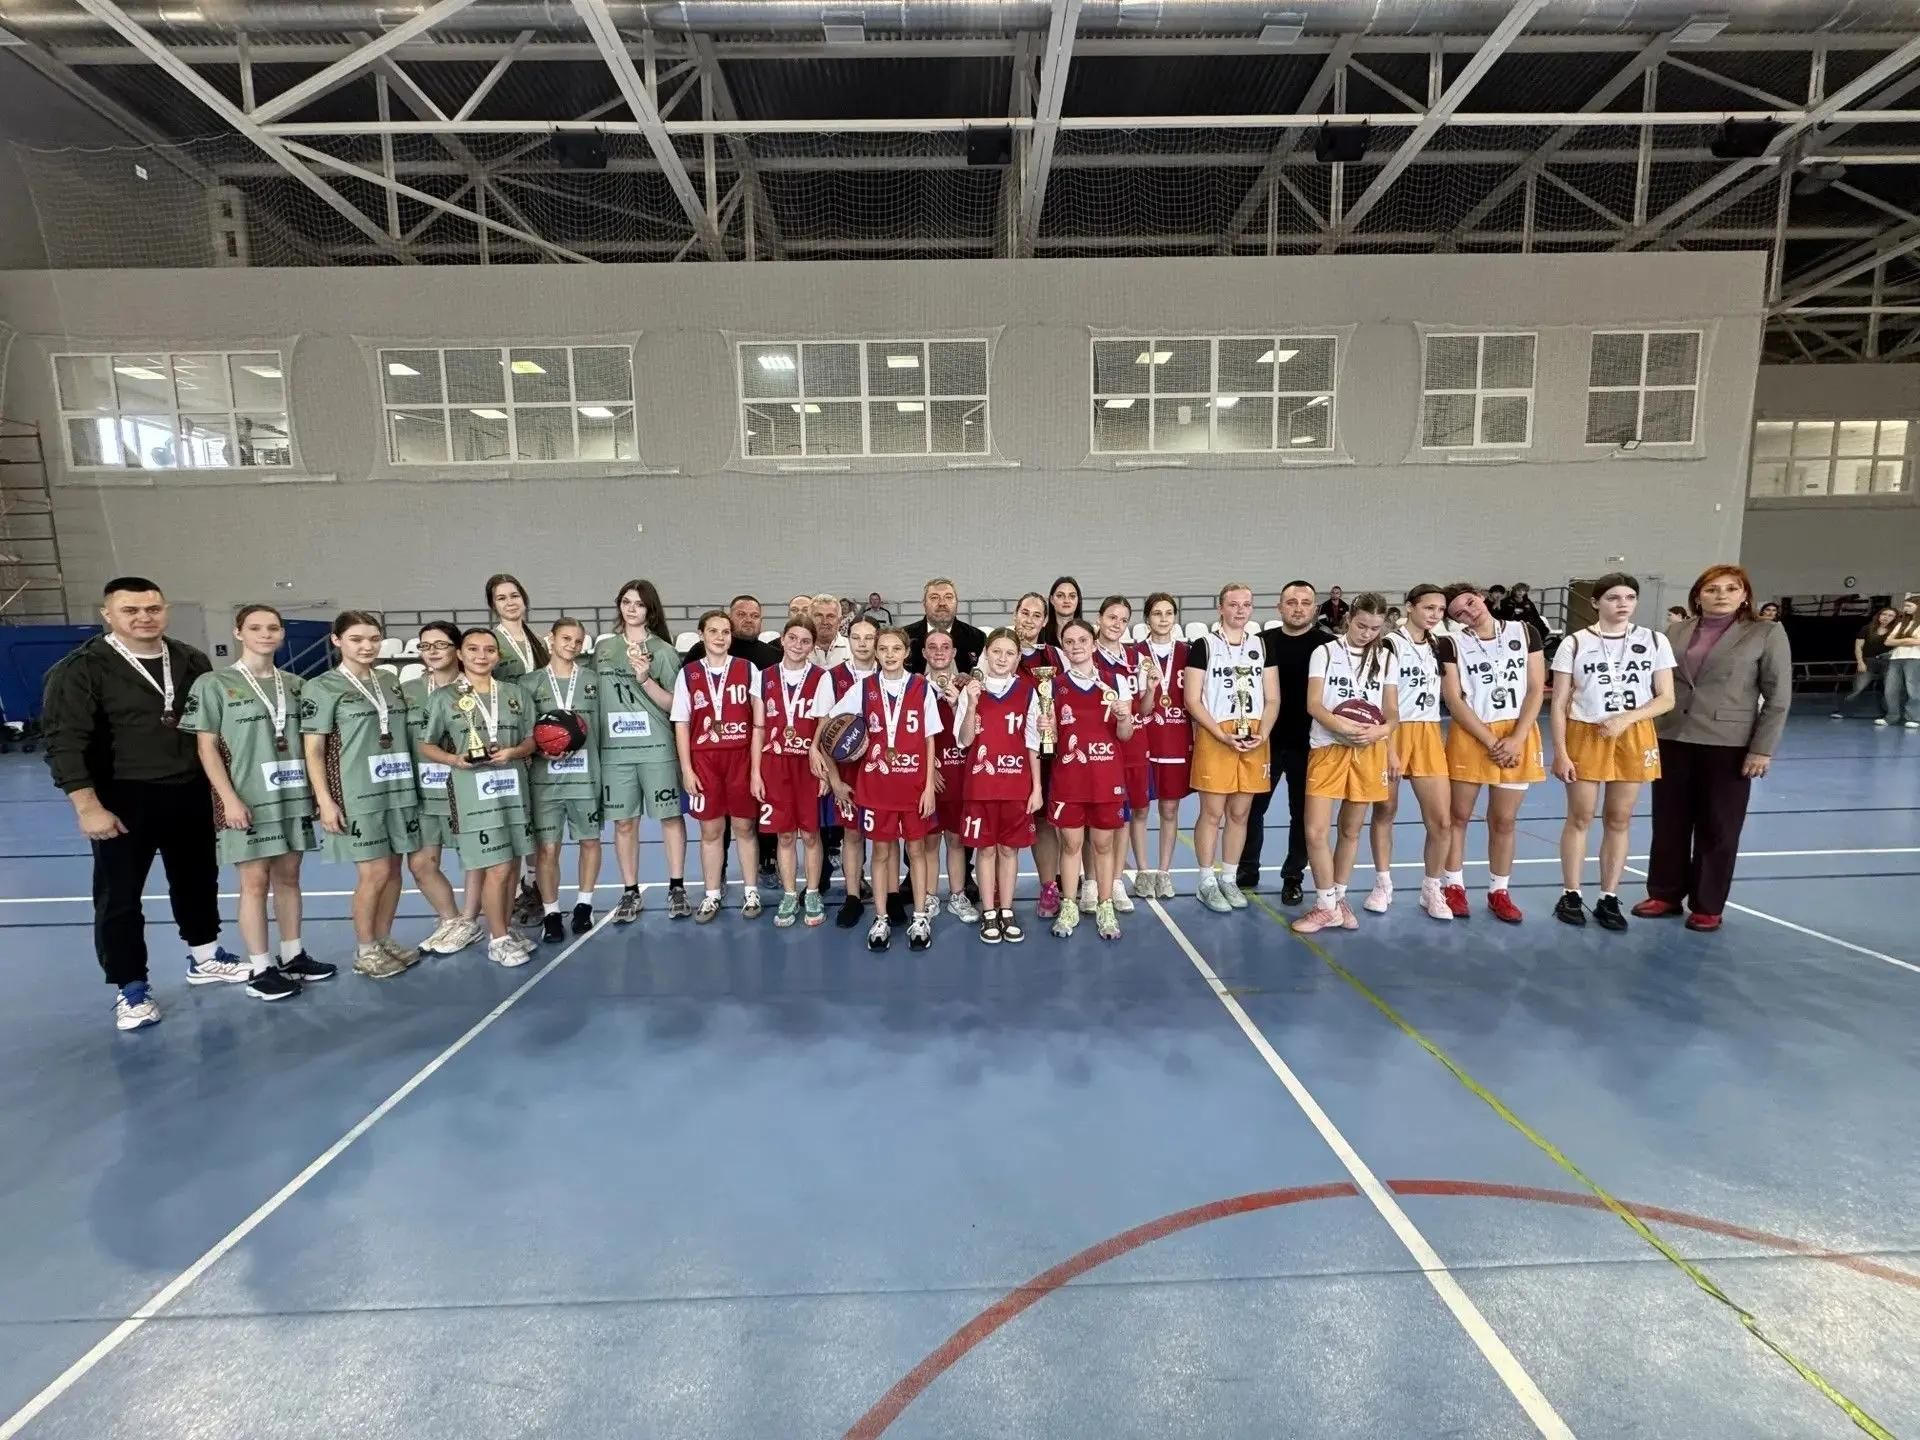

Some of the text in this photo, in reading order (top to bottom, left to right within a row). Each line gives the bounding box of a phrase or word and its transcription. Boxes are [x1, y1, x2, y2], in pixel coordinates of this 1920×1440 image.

[614, 683, 634, 703] 11
[726, 684, 747, 704] 10
[1128, 675, 1139, 695] 9
[1415, 692, 1426, 711] 4
[906, 710, 919, 733] 5
[1005, 712, 1023, 734] 11
[943, 748, 966, 760] КЭС
[1088, 742, 1115, 755] КЭС
[892, 754, 920, 767] КЭС
[997, 755, 1024, 768] КЭС
[864, 809, 875, 831] 5
[1053, 801, 1065, 820] 7
[351, 821, 361, 838] 4
[964, 816, 982, 839] 11
[479, 830, 489, 845] 6
